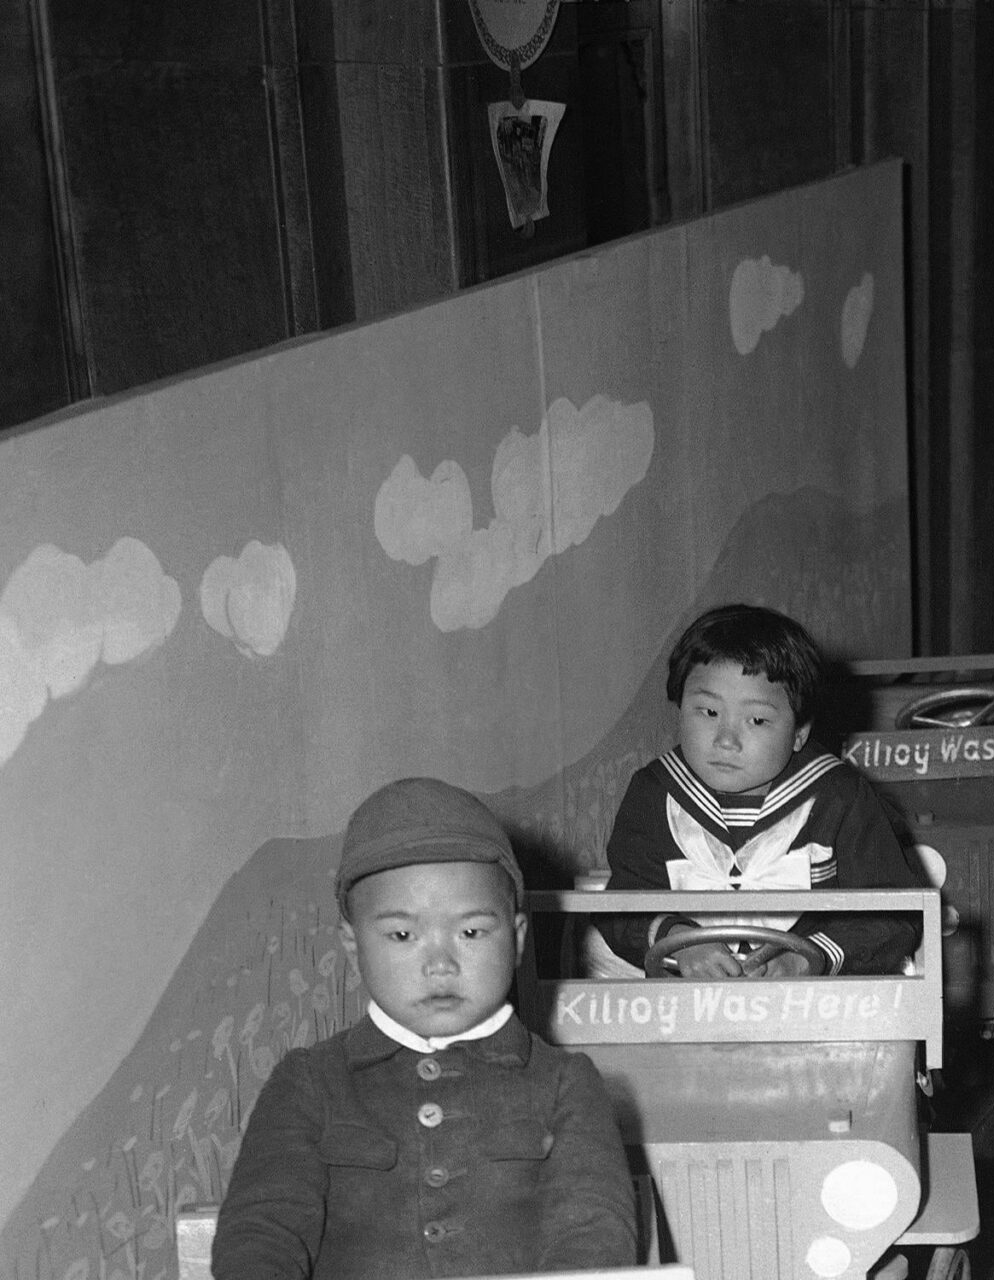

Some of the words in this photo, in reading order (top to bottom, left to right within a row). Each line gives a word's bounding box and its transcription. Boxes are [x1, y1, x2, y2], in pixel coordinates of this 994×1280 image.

[841, 739, 931, 774] Kilroy
[557, 990, 678, 1037] Kilroy
[694, 986, 770, 1024] Was
